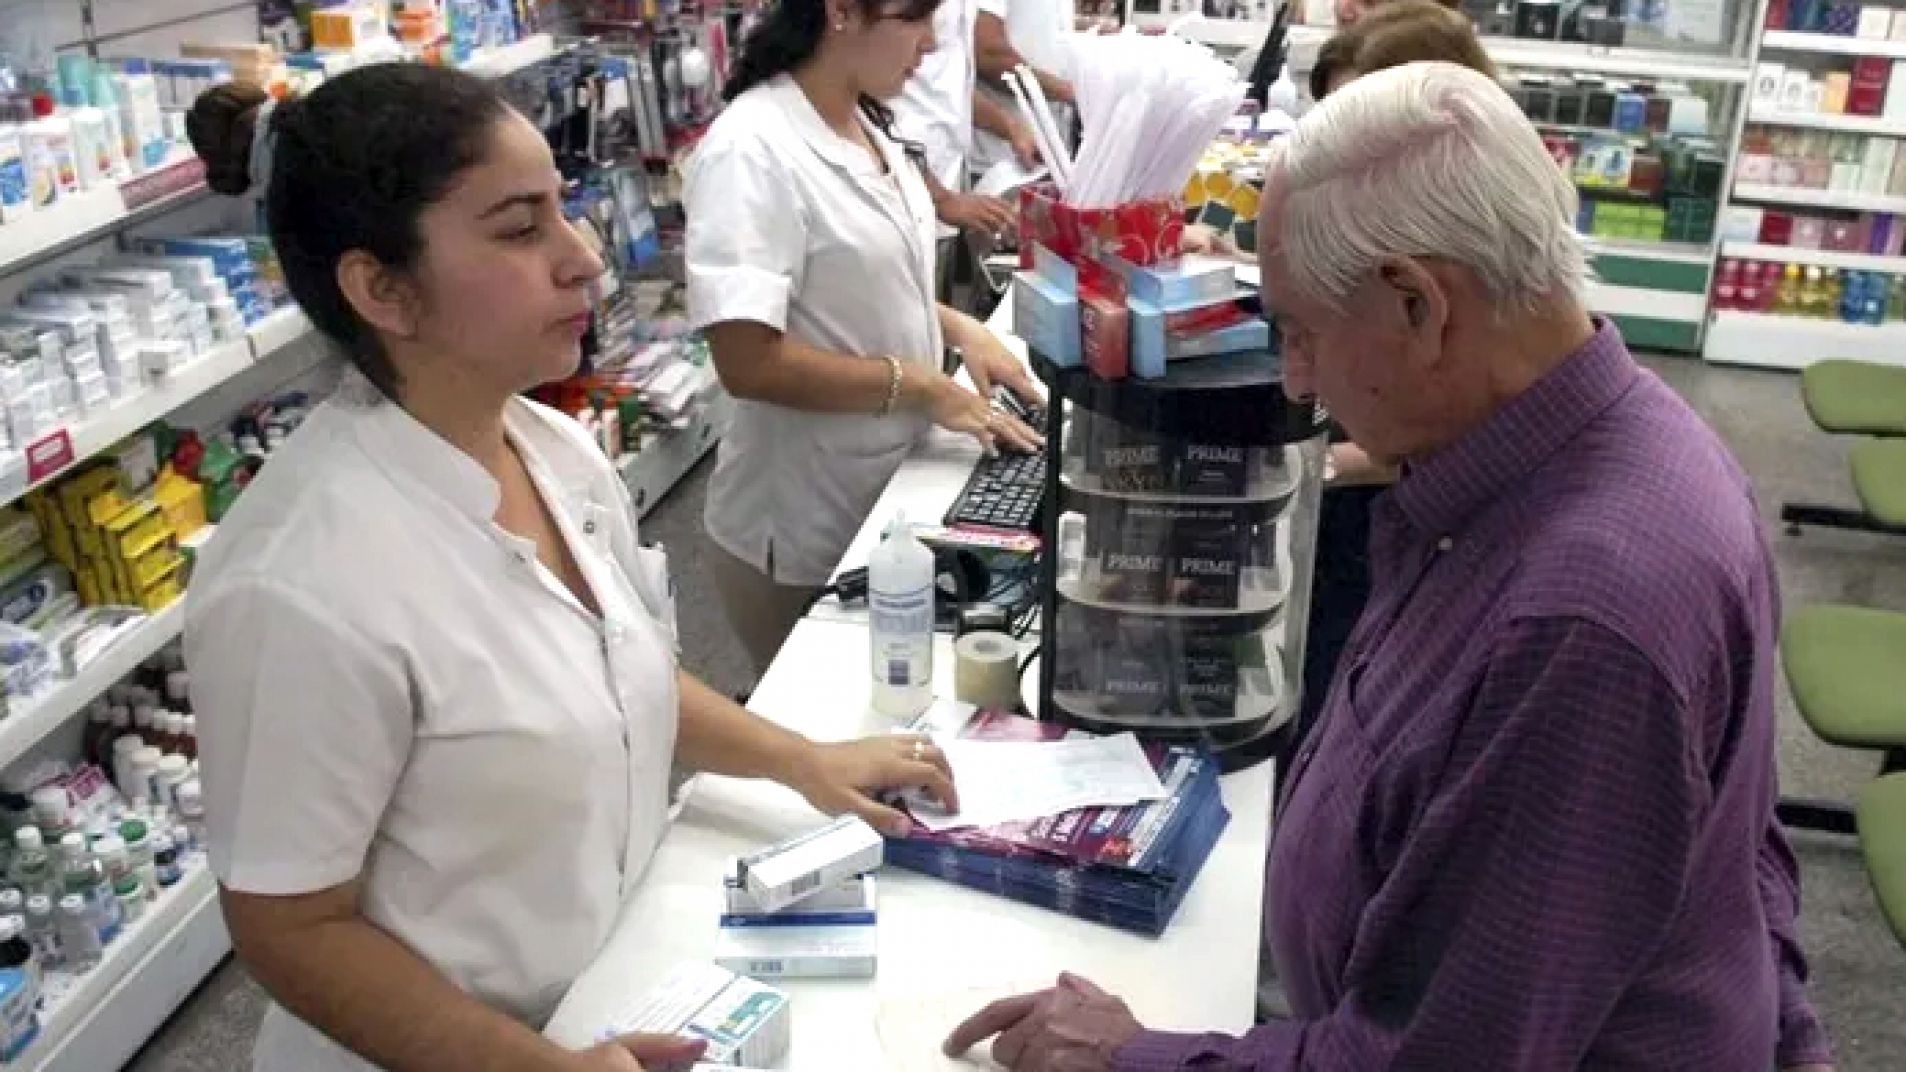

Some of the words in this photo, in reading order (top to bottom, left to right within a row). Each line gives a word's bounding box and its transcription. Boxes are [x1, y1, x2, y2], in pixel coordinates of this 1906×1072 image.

[1187, 445, 1242, 463] PRIME
[1108, 553, 1162, 571] PRIME
[1182, 558, 1236, 575] PRIME
